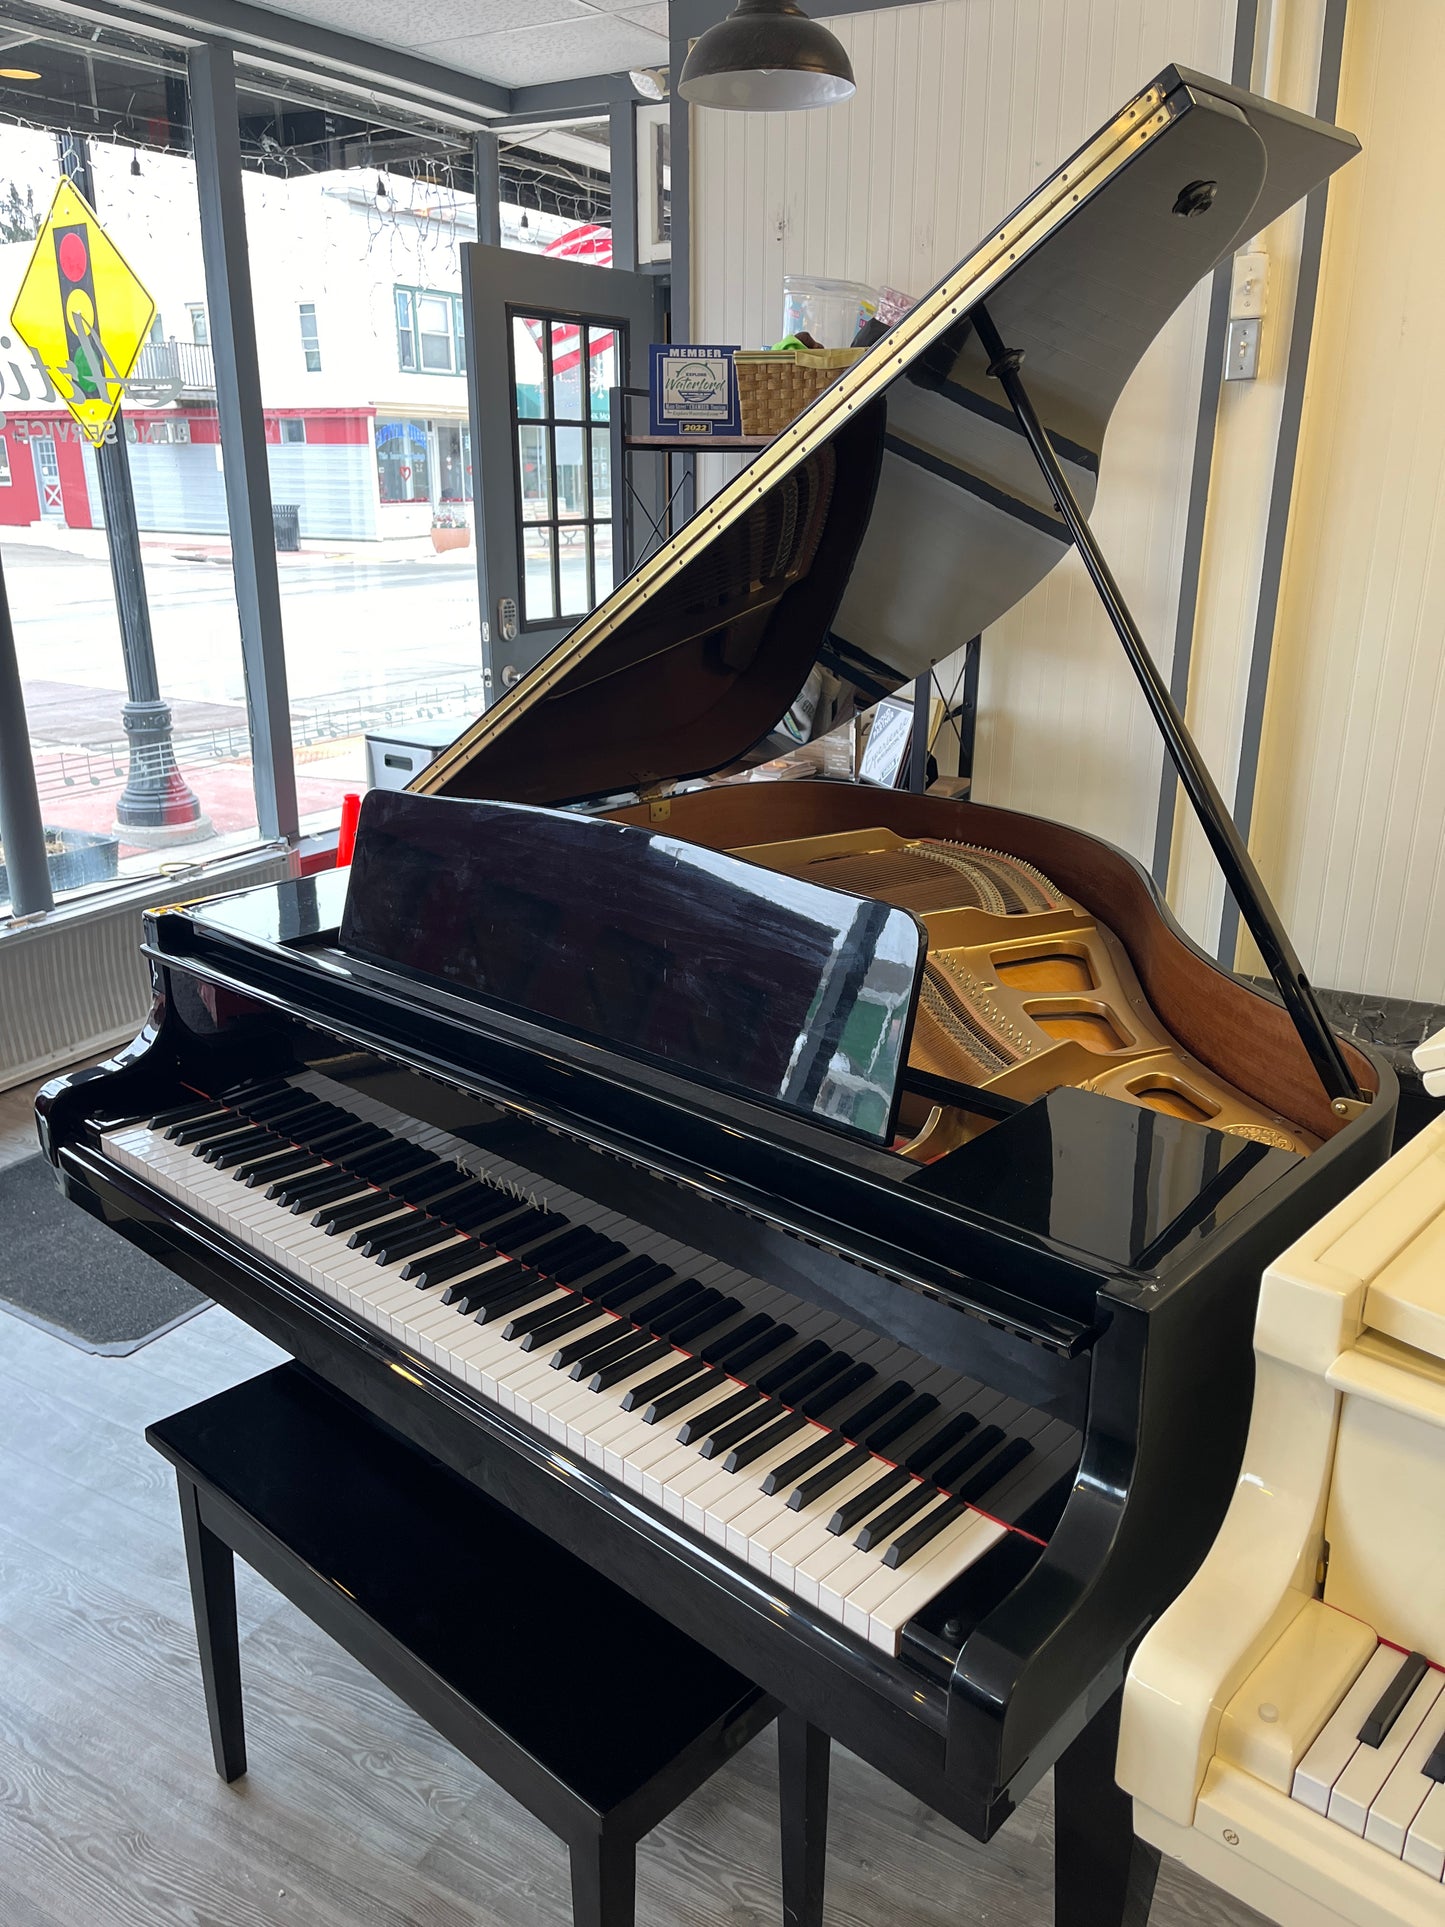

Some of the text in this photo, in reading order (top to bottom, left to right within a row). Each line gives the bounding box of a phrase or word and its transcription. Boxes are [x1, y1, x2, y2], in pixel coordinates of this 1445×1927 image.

[669, 348, 721, 358] MEMBER
[665, 377, 726, 391] Waterford
[684, 424, 707, 432] 2022
